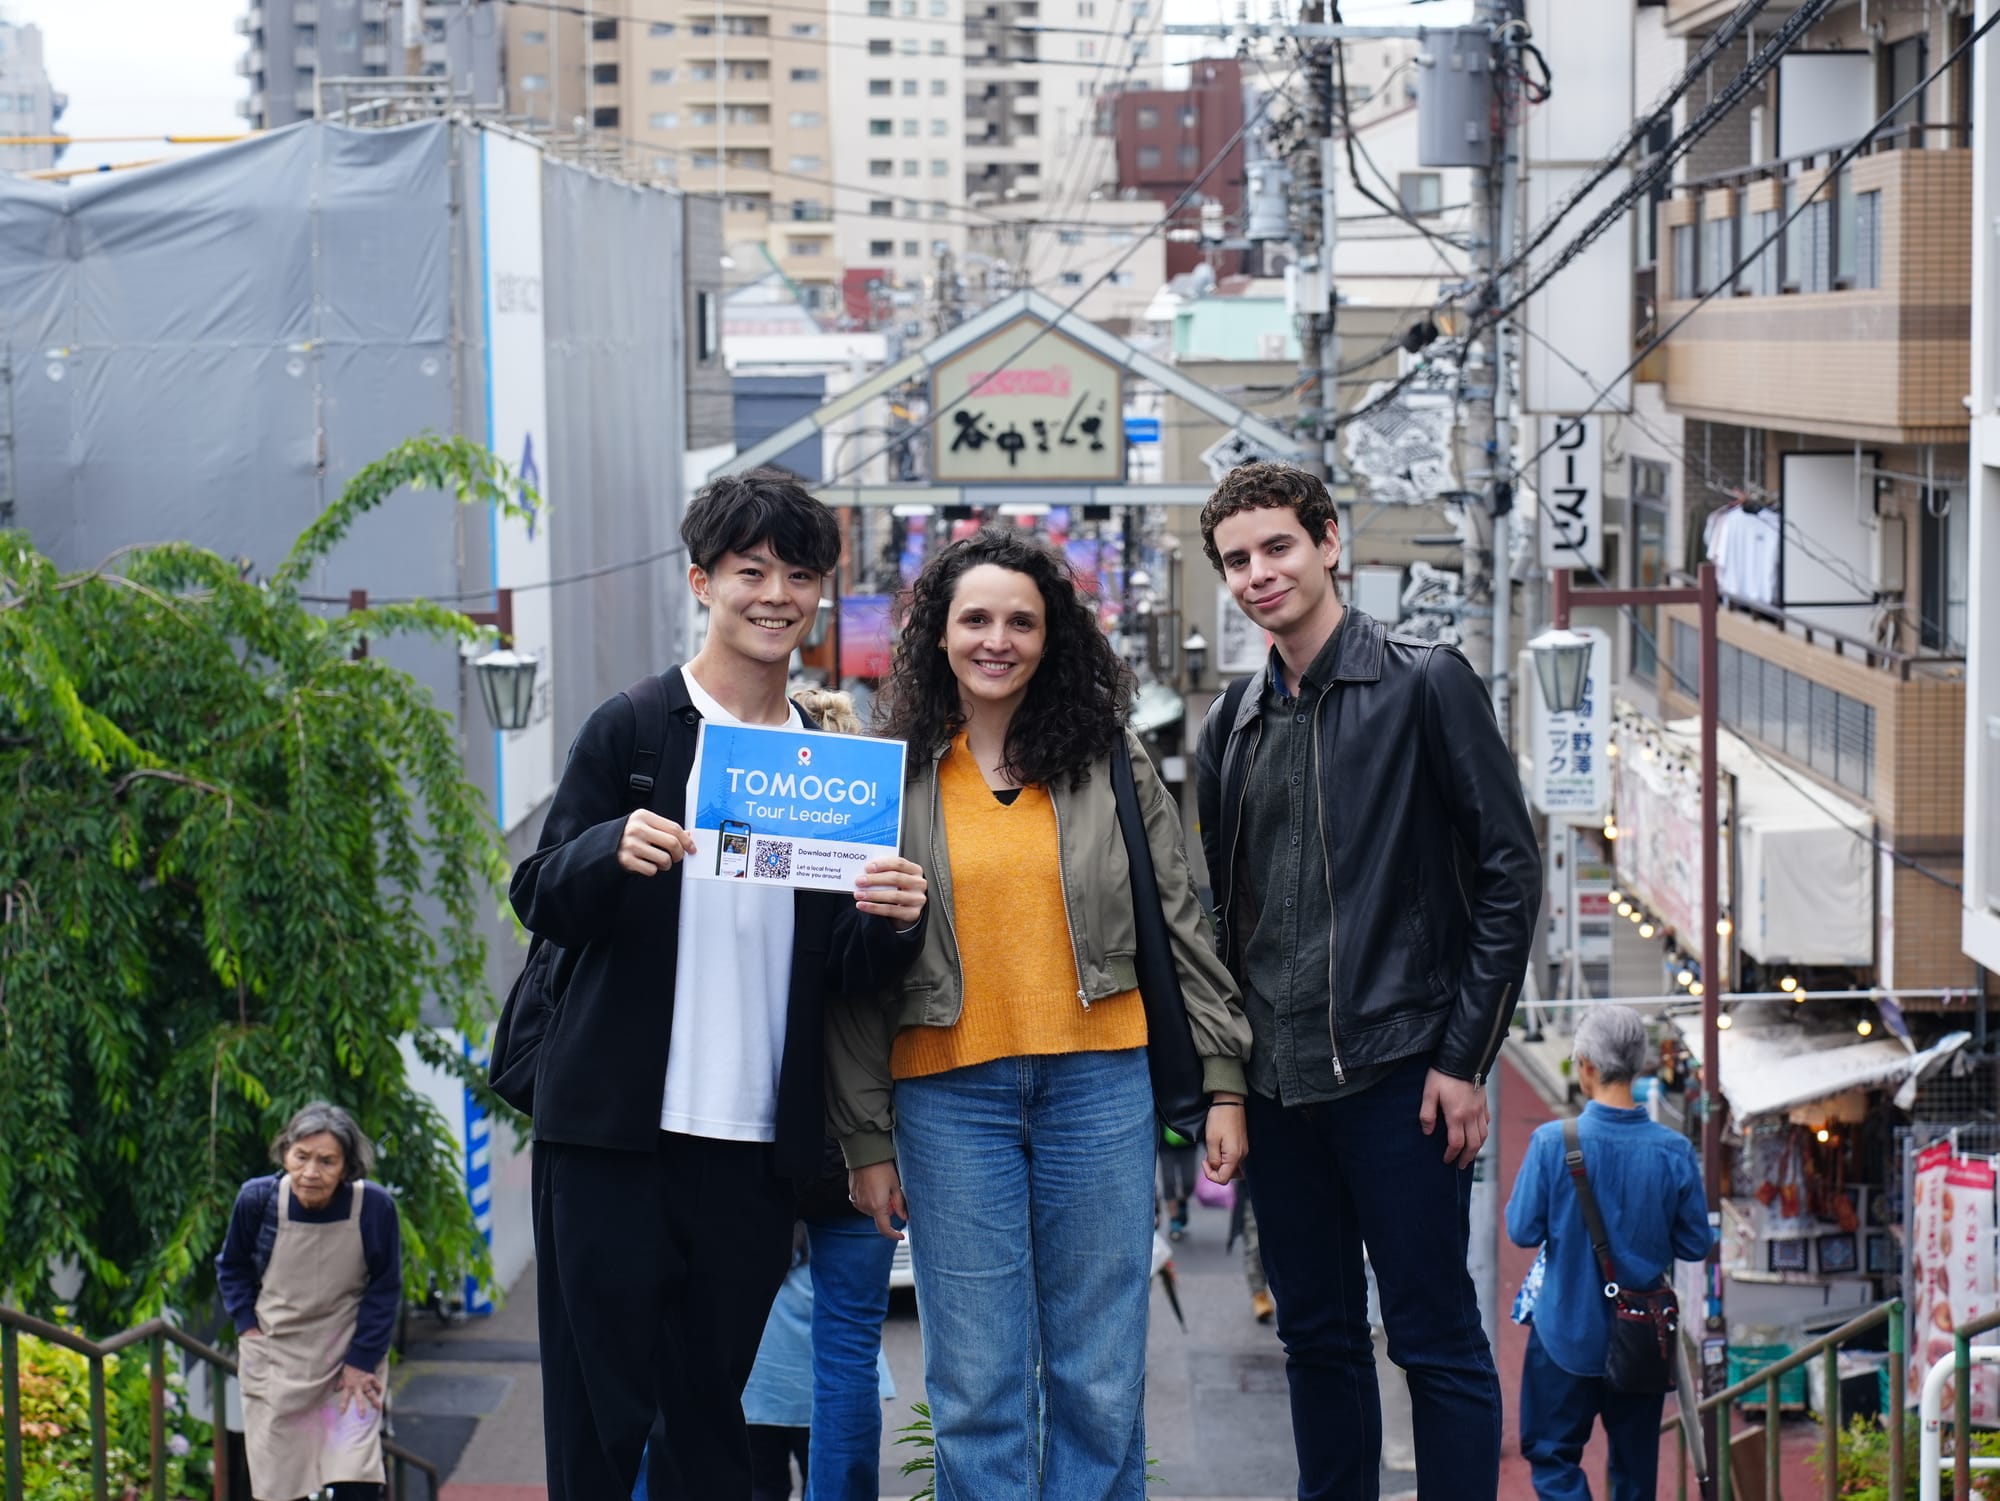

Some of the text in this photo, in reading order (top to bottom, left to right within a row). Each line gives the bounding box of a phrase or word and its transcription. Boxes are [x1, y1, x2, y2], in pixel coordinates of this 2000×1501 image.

[950, 390, 1106, 468] 谷中ぎんざ
[726, 767, 877, 807] TOMOGO!
[745, 801, 851, 825] Tour Leader
[798, 848, 832, 858] Download
